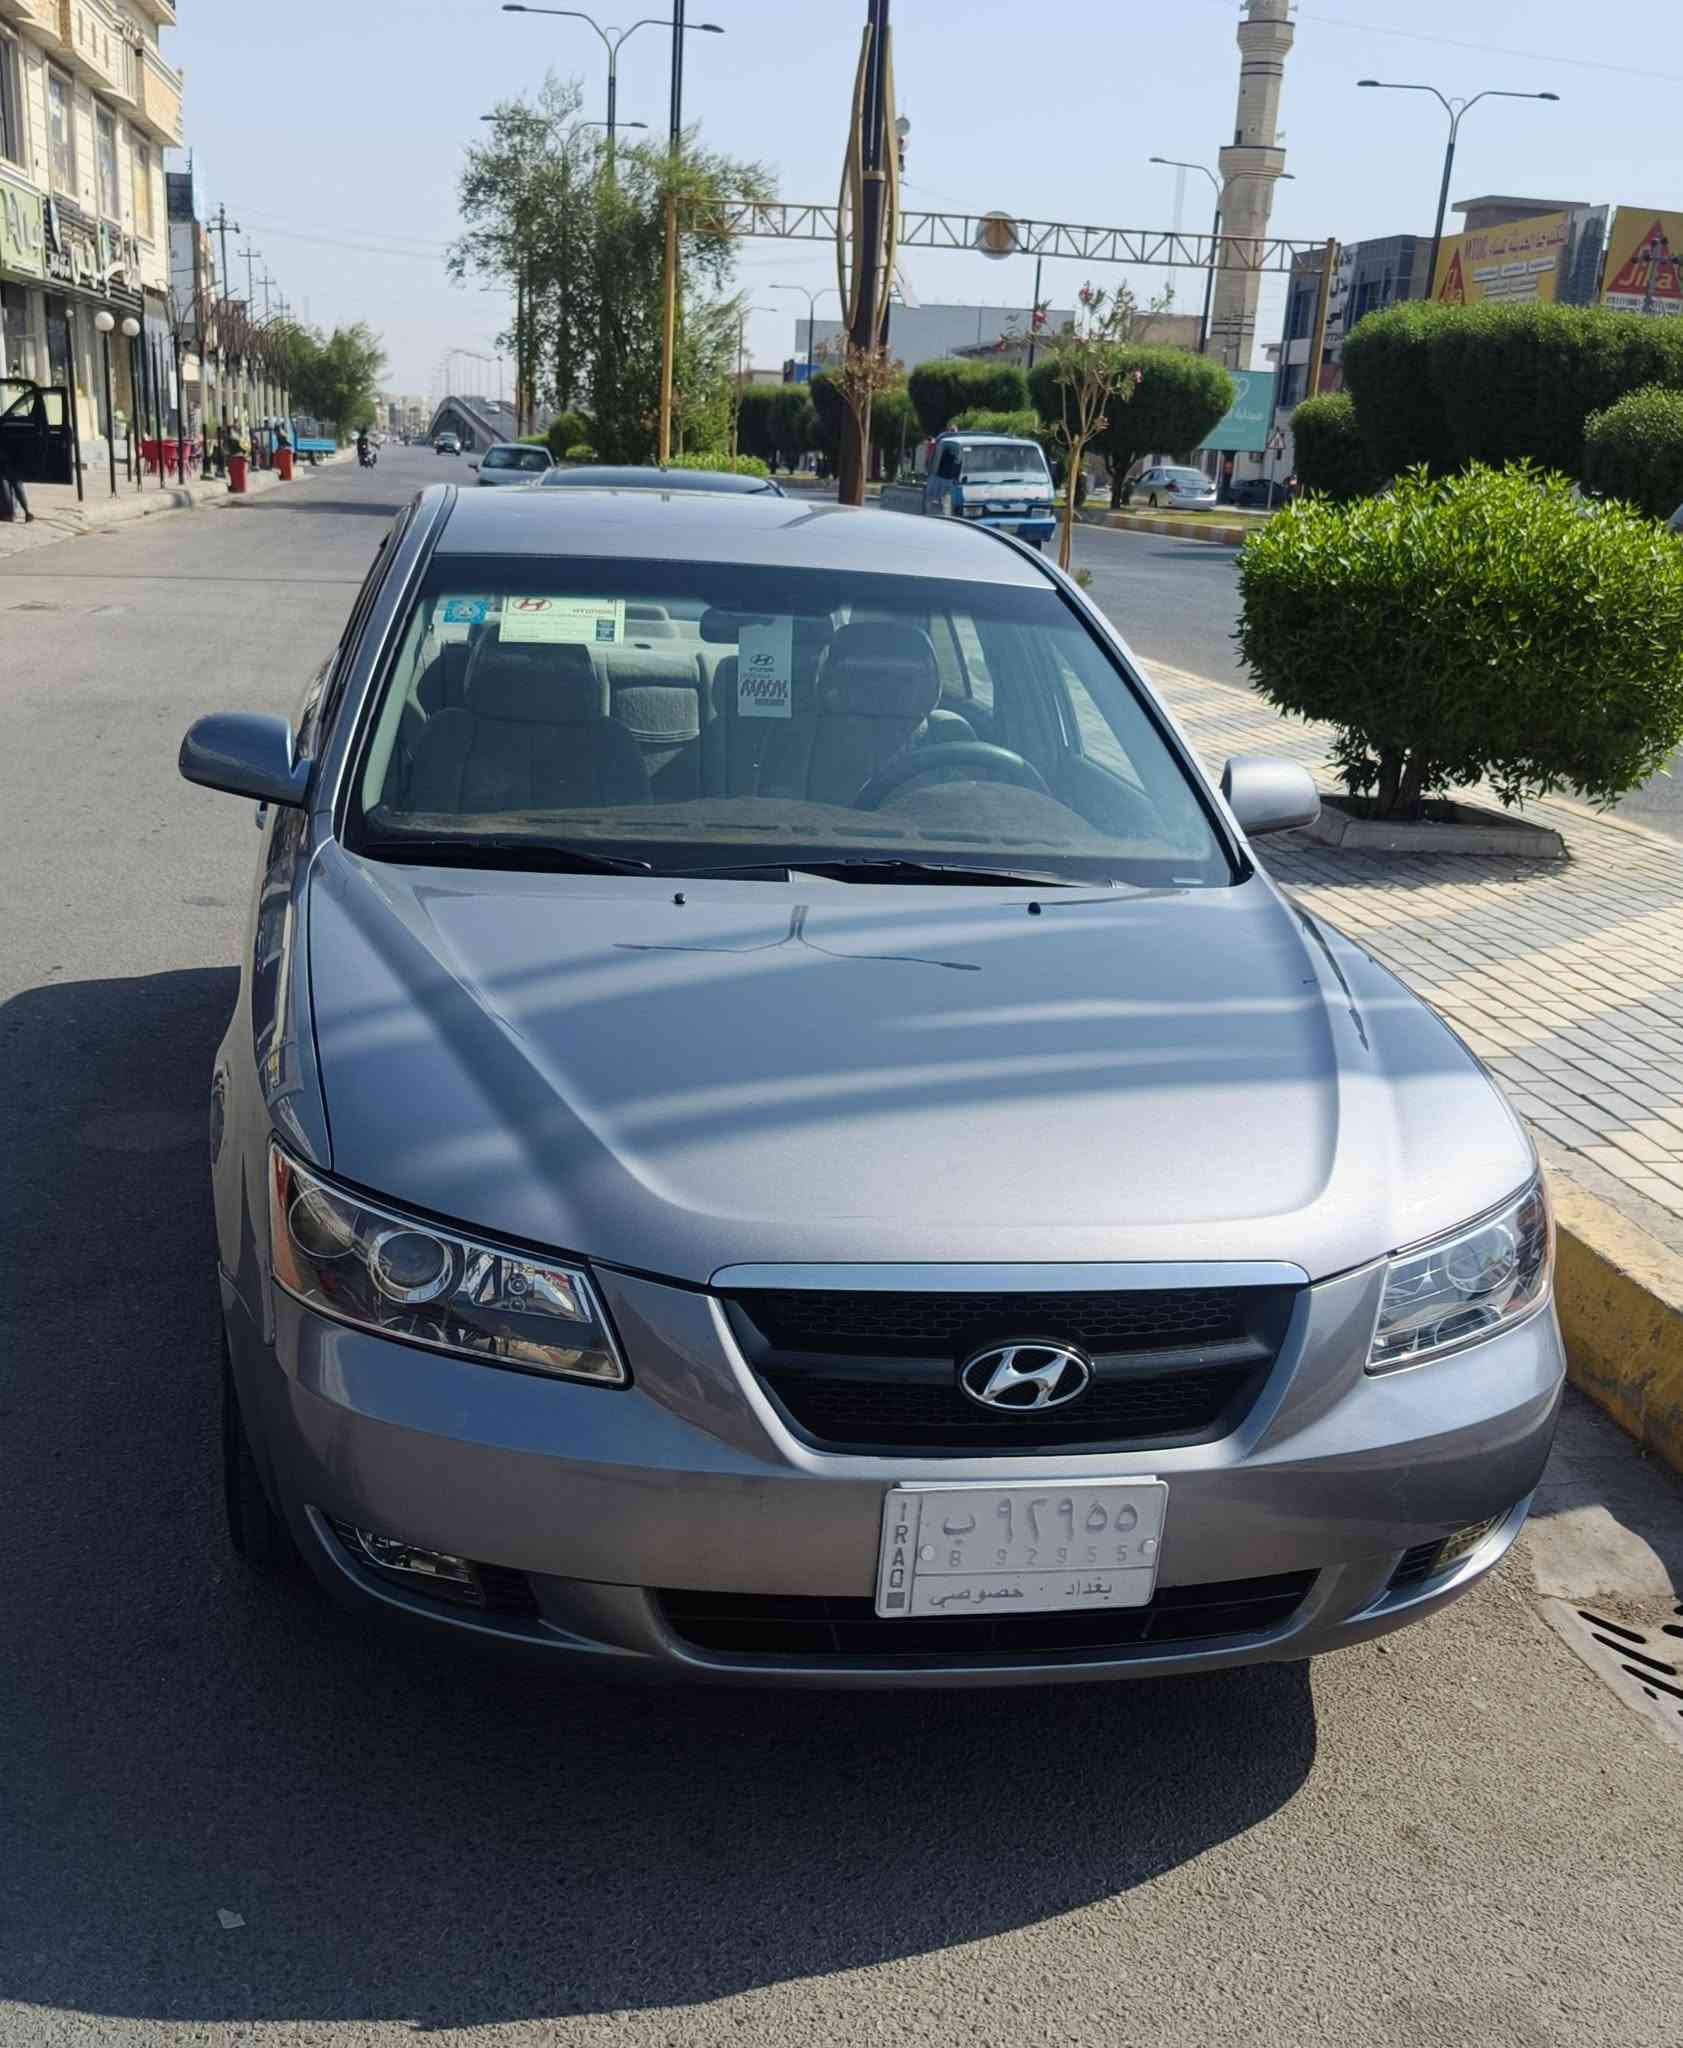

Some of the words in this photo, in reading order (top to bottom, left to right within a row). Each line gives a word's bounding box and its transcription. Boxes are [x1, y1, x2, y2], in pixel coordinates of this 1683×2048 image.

[889, 1502, 910, 1589] IRAQ
[995, 1544, 1128, 1567] 92955
[929, 1574, 1024, 1608] خصوصي
[1064, 1577, 1113, 1600] بغداد
